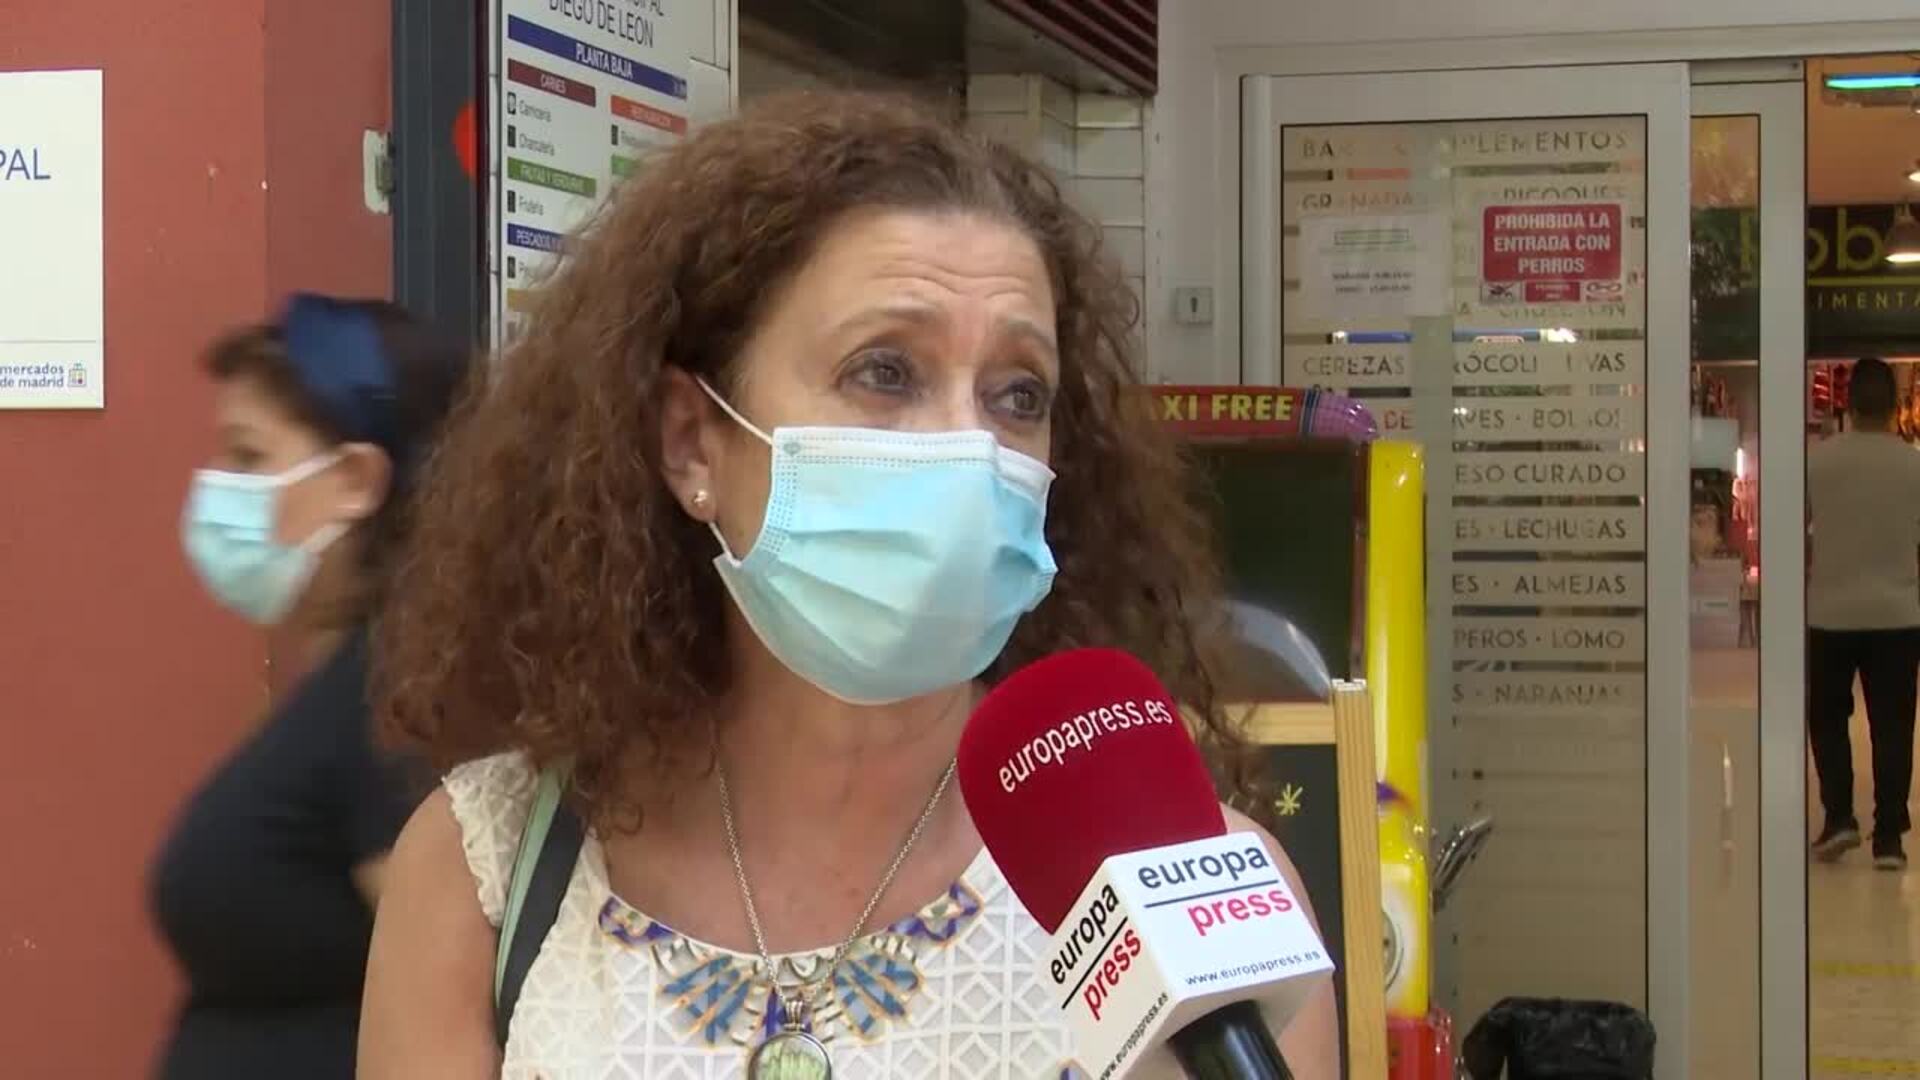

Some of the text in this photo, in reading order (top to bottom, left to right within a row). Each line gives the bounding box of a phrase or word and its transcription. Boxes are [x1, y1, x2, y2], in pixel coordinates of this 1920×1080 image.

[597, 0, 615, 34] DE
[618, 8, 654, 48] LEON
[575, 42, 634, 79] PLANTA BAJA
[1452, 130, 1627, 153] PLEMENTOS
[1494, 212, 1611, 230] PROHIBIDA LA
[1493, 234, 1611, 252] ENTRADA CON
[1518, 257, 1585, 274] PERROS
[0, 363, 64, 375] mercados
[1303, 354, 1405, 376] CEREZAS
[0, 377, 64, 388] de madrid
[1150, 394, 1294, 421] XI FREE
[1383, 409, 1415, 430] DE
[1513, 464, 1626, 484] CURADO
[1452, 574, 1627, 595] ES ALMEJAS
[1551, 628, 1626, 649] LOMO
[998, 699, 1174, 793] europapress.es
[1138, 843, 1270, 890] europa
[1187, 888, 1294, 937] press
[1050, 881, 1120, 986] europa
[1082, 926, 1142, 1021] press
[1185, 950, 1321, 988] www.europapress.es
